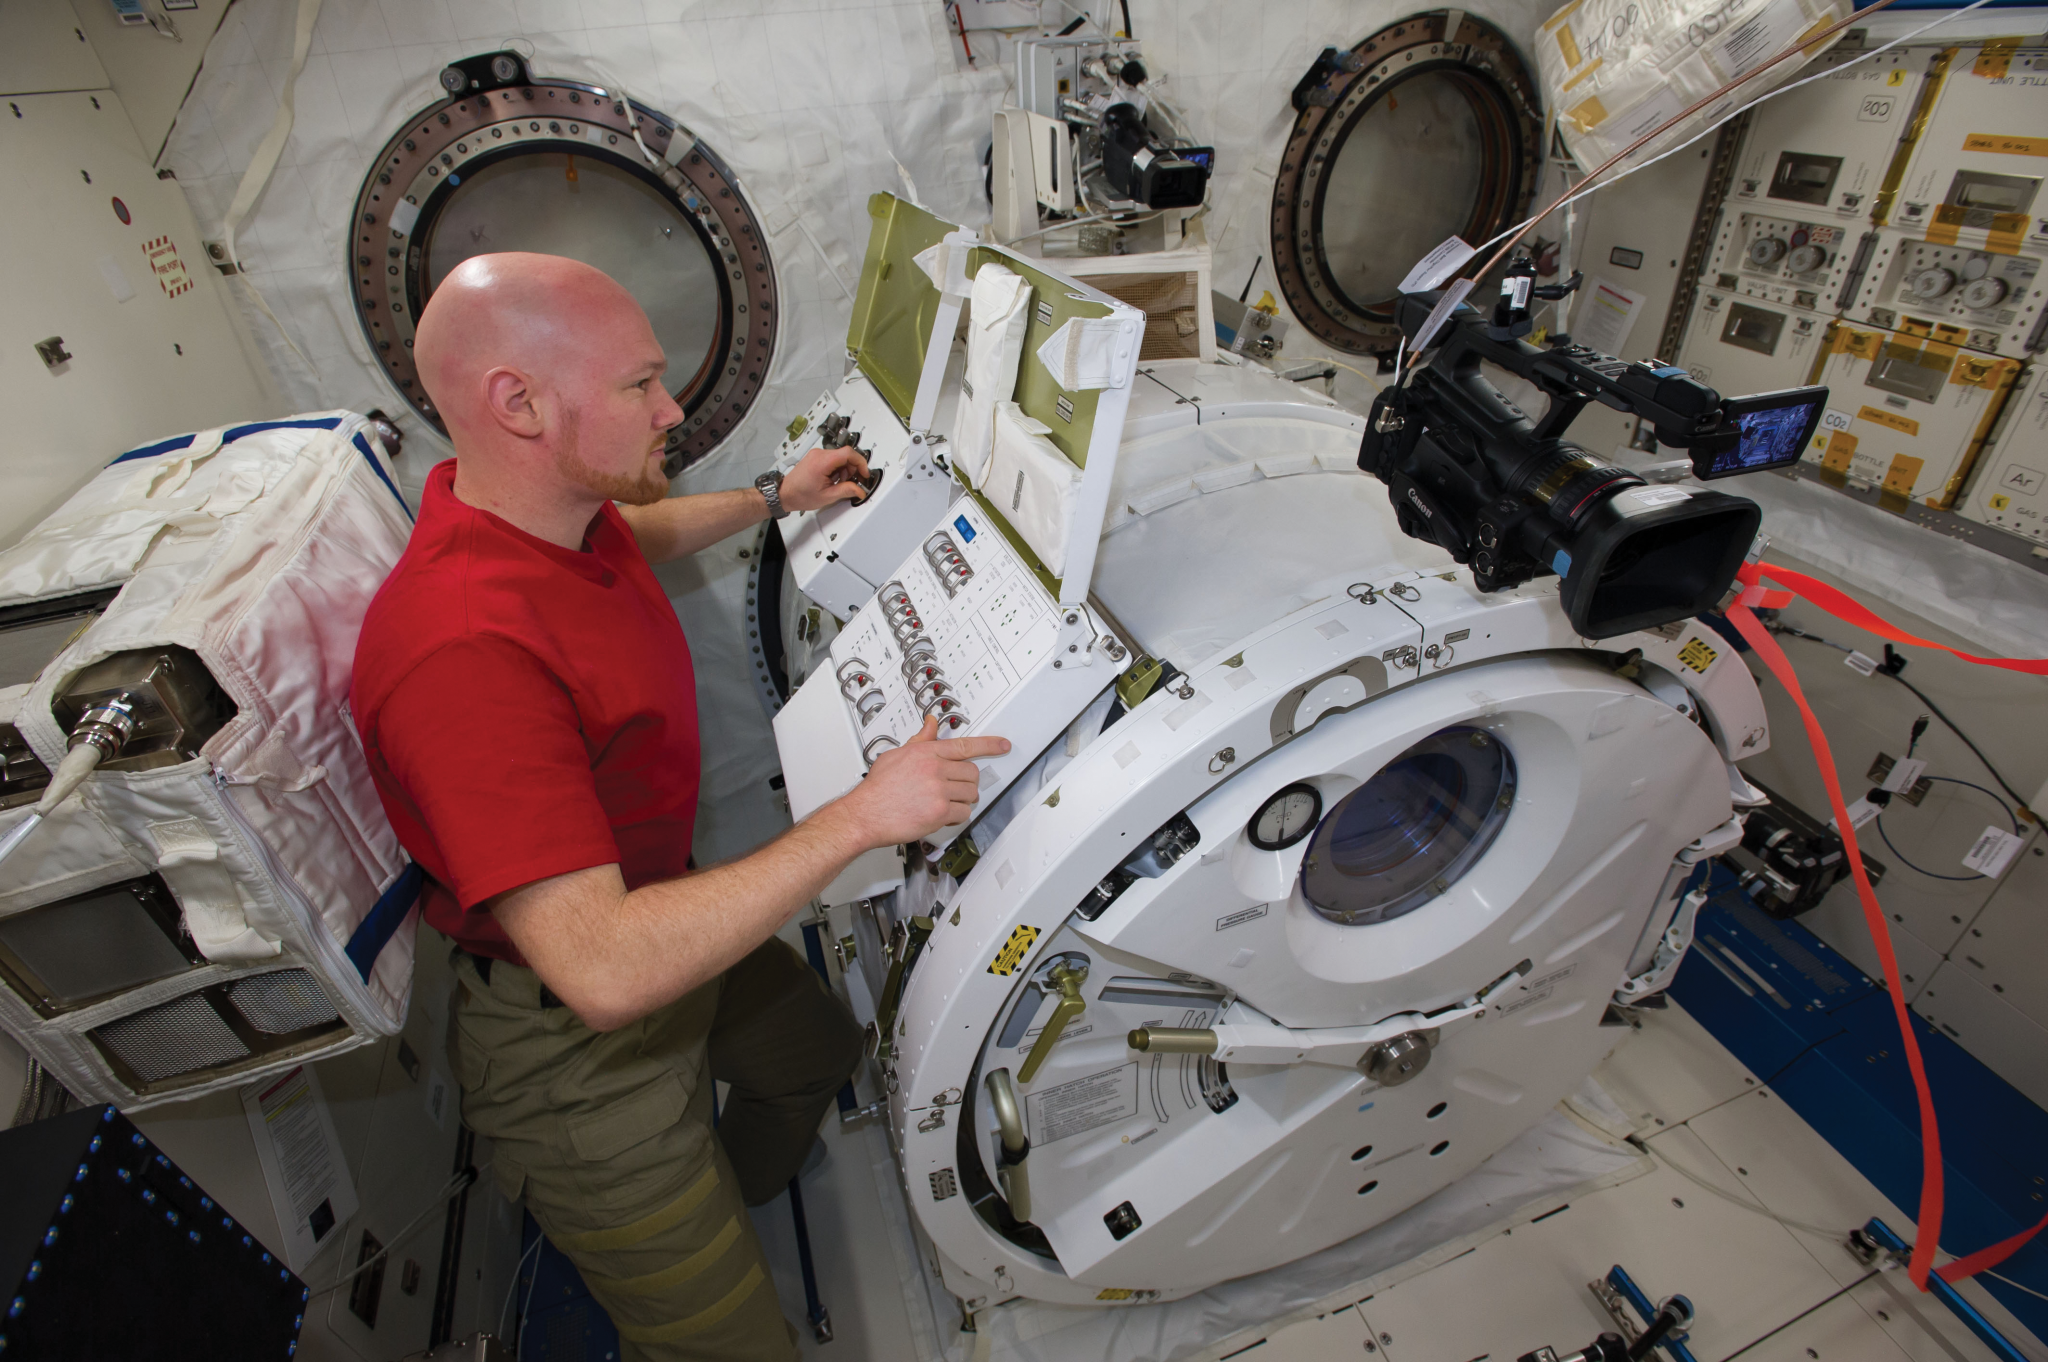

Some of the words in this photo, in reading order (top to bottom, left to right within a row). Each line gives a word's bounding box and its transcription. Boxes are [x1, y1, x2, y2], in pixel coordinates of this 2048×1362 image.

[1863, 101, 1891, 117] CO2
[157, 265, 169, 274] FIRE
[167, 260, 179, 270] PORT
[1747, 281, 1768, 293] VALVE
[1771, 286, 1788, 296] UNIT
[1689, 367, 1708, 381] CO2
[1825, 413, 1847, 429] CO2
[1853, 451, 1884, 468] BOTTLE
[2009, 473, 2034, 486] Ar
[1407, 487, 1433, 519] Canon
[2016, 507, 2038, 519] GAS
[1220, 916, 1245, 928] PRESSURE
[1226, 908, 1259, 922] DIFFERENTIAL
[996, 948, 1012, 967] CAUTION
[1042, 1087, 1061, 1096] INNER
[1064, 1079, 1084, 1089] HATCH
[1087, 1068, 1122, 1082] OPERATION
